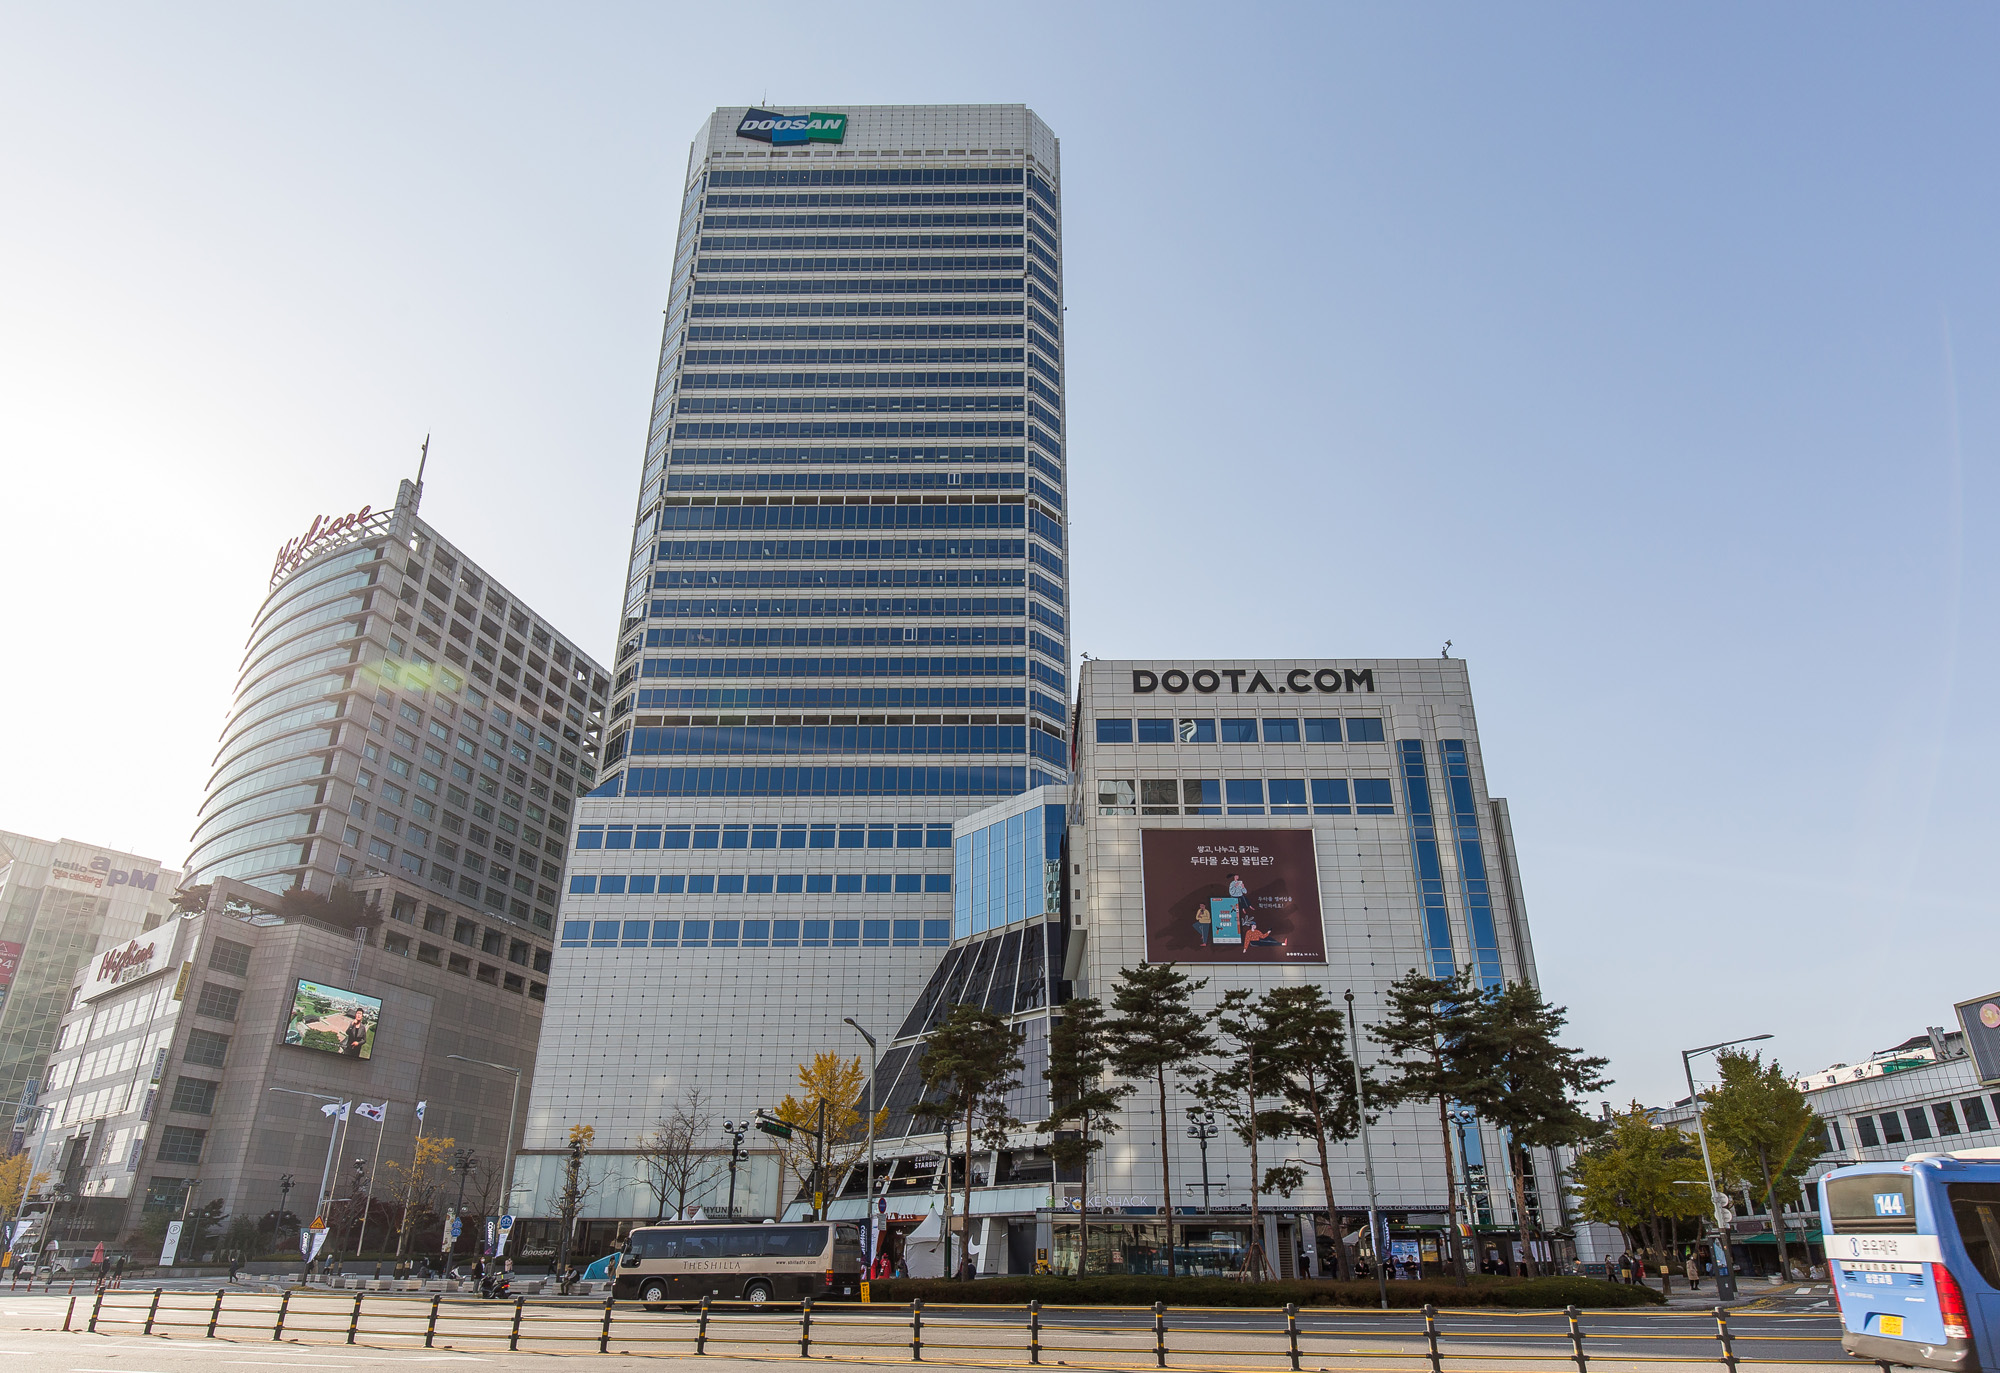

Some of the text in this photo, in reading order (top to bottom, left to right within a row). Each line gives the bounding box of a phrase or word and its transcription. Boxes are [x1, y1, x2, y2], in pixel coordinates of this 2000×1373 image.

[740, 119, 842, 131] DOOSAN
[270, 505, 371, 579] Migliore
[1132, 668, 1375, 694] DOOTA.COM
[1238, 845, 1260, 854] 즐기는
[1190, 856, 1274, 866] 두타몰 쇼핑 꿀팁은?
[914, 1160, 940, 1169] STARBUC
[1063, 1195, 1148, 1207] SKE SHACK
[1877, 1194, 1902, 1214] 144
[703, 1206, 743, 1214] HYUNAI
[1862, 1239, 1898, 1255] 유유제약
[1850, 1263, 1904, 1272] HYUNDAI
